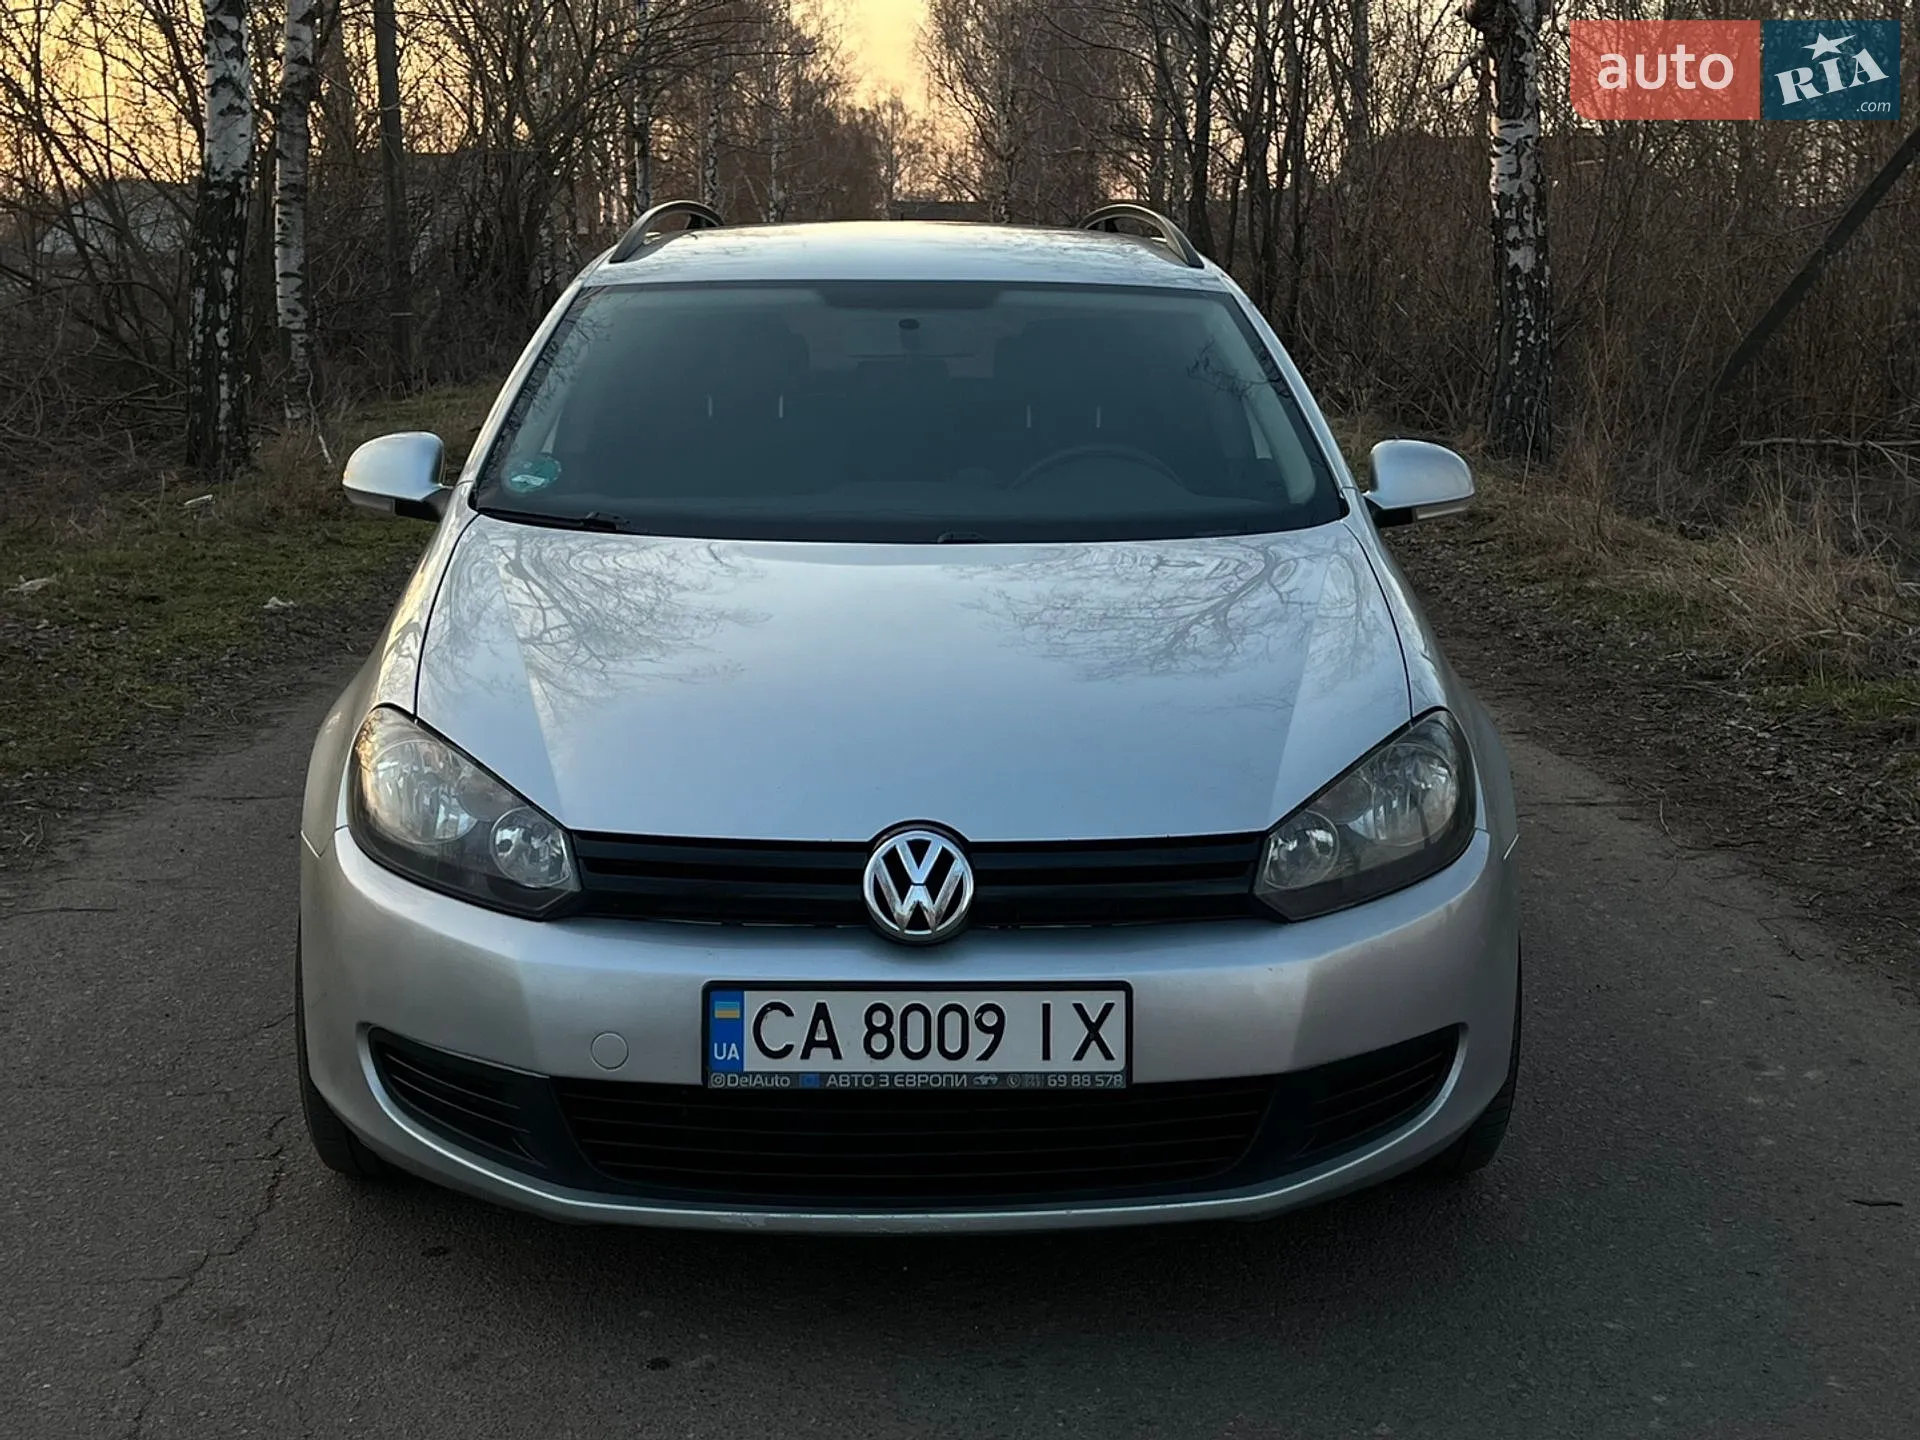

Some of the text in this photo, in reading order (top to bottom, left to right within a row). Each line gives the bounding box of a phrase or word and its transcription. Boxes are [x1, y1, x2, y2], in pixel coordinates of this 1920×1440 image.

[753, 1001, 843, 1061] CA
[863, 1002, 1006, 1061] 8009
[714, 1043, 739, 1060] UA
[826, 1073, 875, 1088] АВТО
